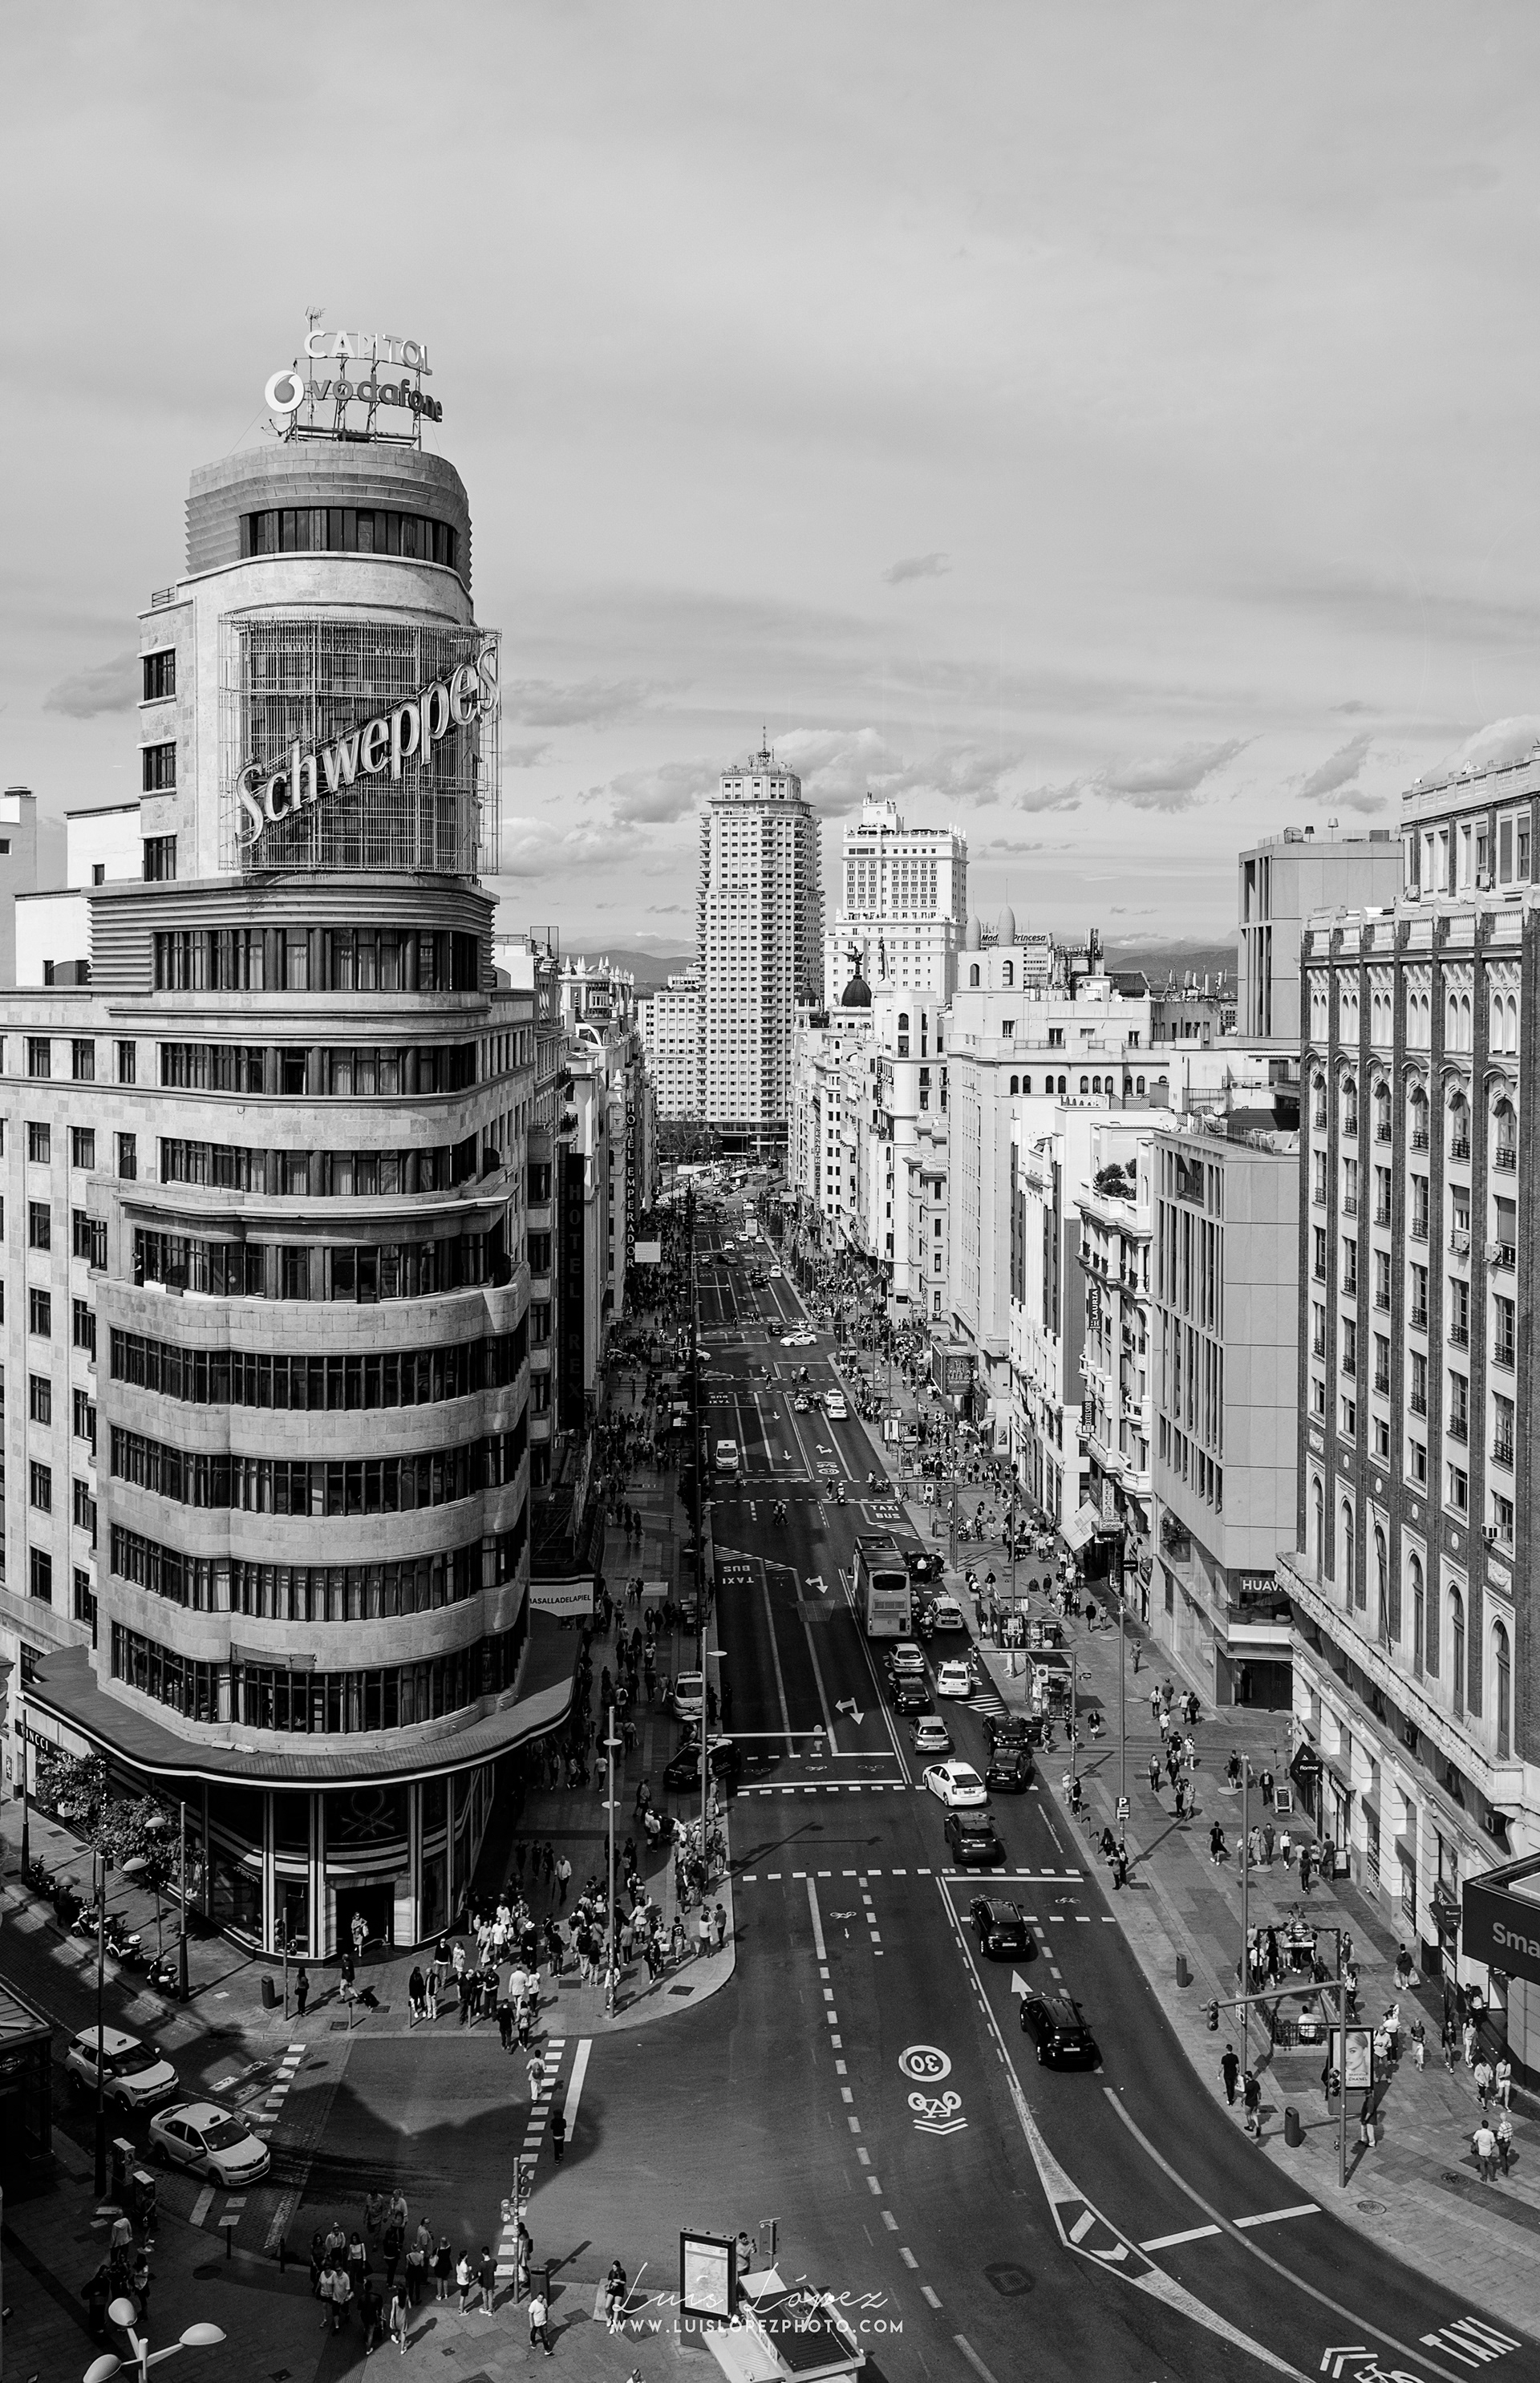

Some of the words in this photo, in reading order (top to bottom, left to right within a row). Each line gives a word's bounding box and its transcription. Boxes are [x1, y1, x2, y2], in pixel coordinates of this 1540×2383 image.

[304, 330, 432, 375] CAPITOL
[310, 375, 443, 422] vodafone
[236, 638, 499, 847] Schweppes
[626, 1104, 636, 1160] HOTEL
[569, 1185, 582, 1299] HOTEL
[626, 1167, 635, 1268] EMPERADOR
[569, 1334, 582, 1399] REX
[910, 2055, 939, 2073] 30
[1419, 2316, 1522, 2368] TAXI
